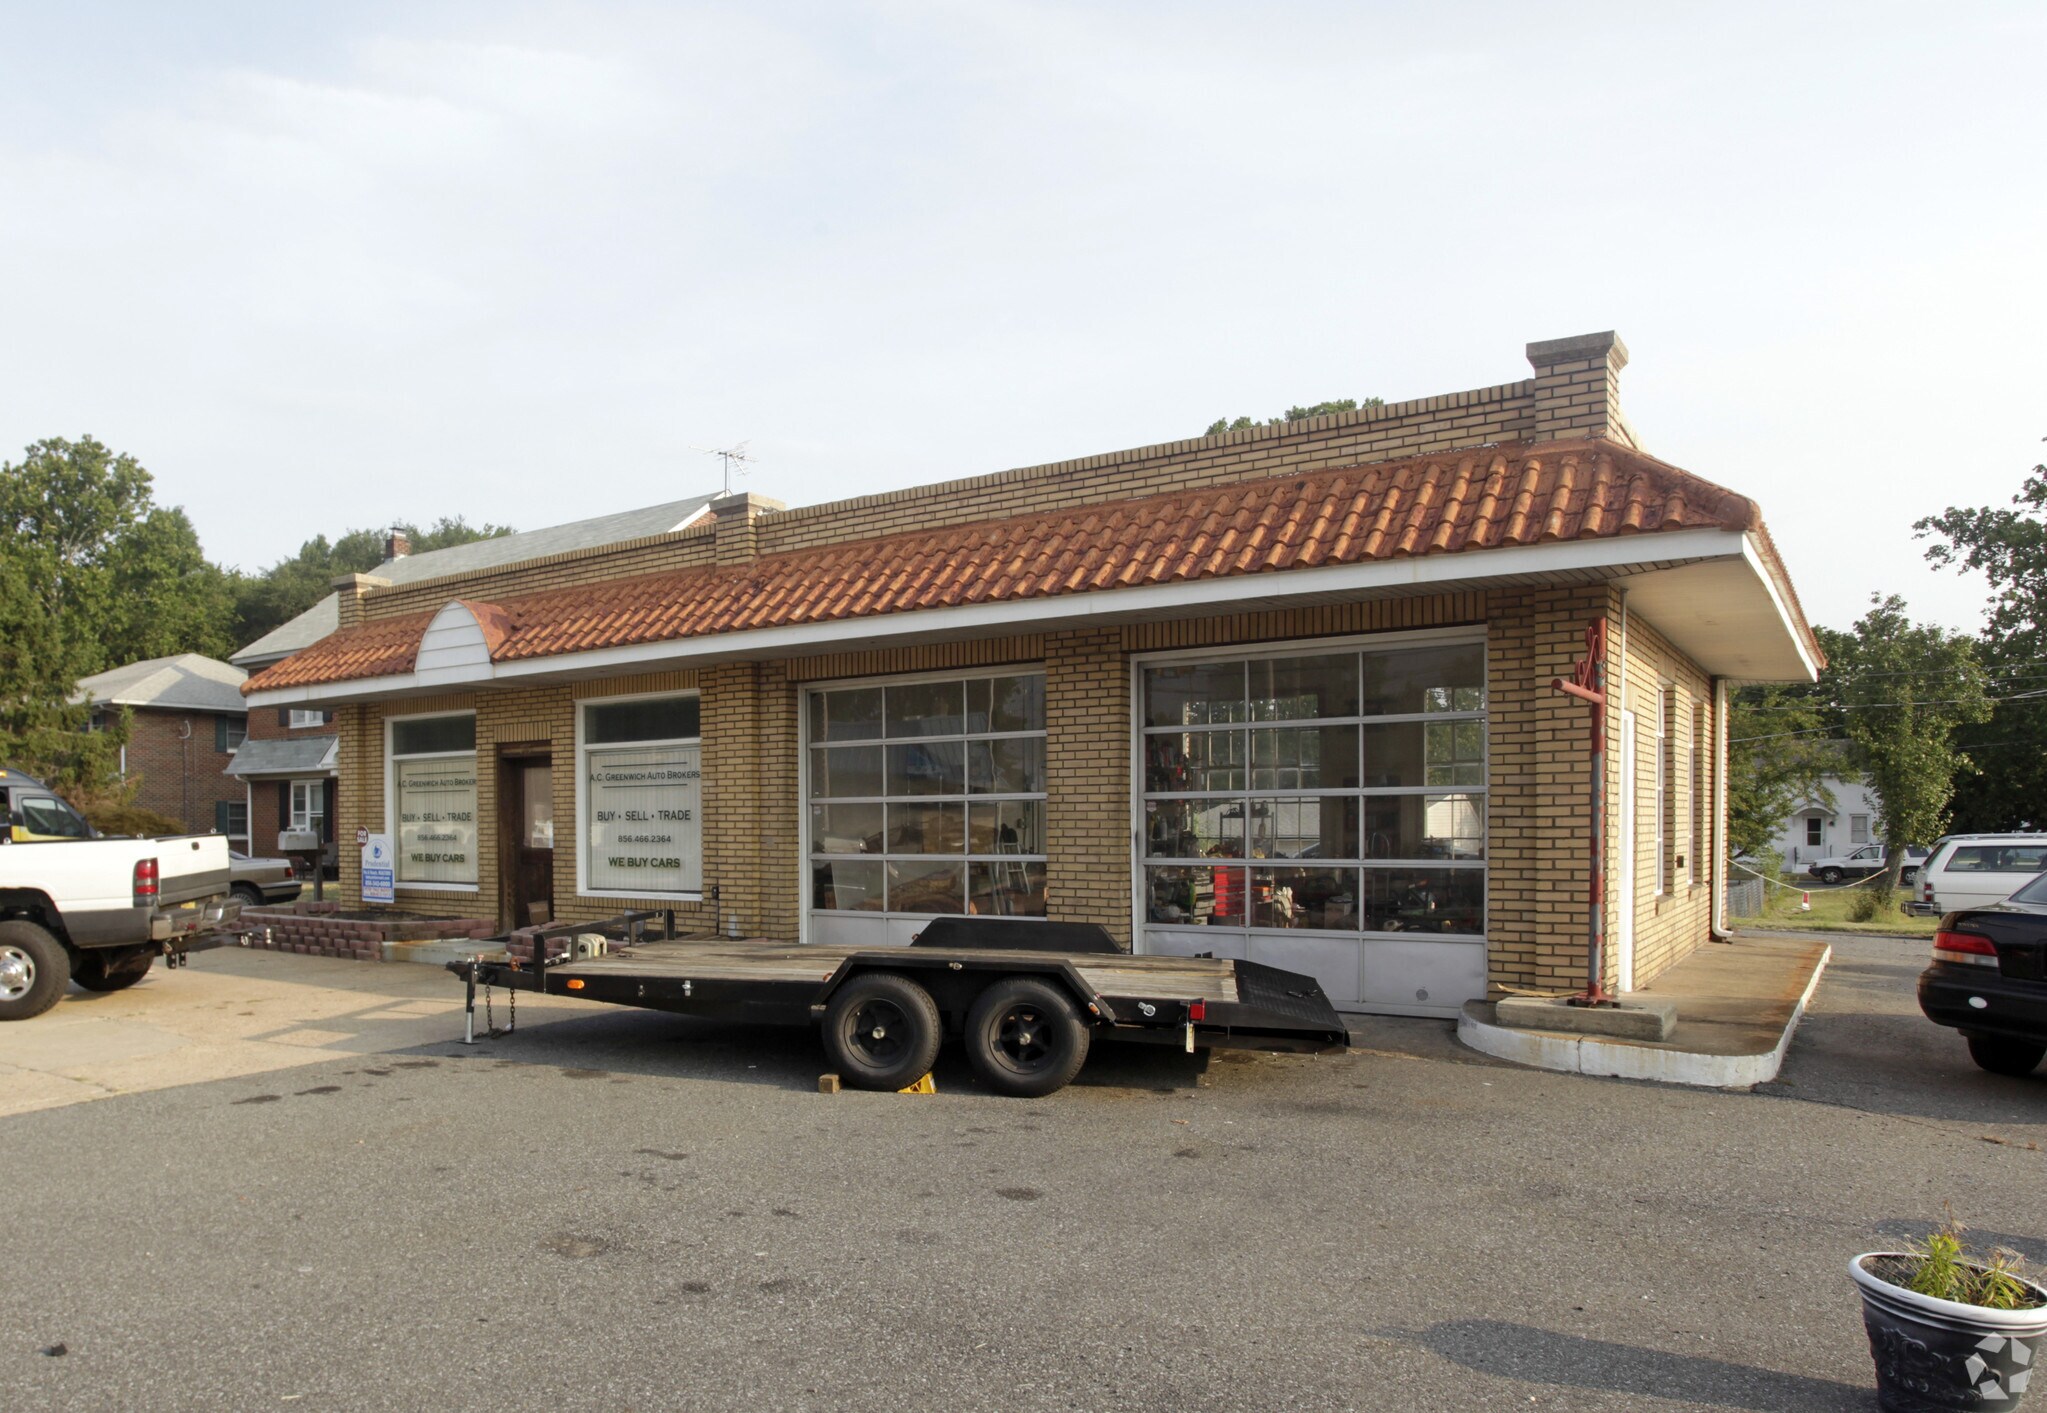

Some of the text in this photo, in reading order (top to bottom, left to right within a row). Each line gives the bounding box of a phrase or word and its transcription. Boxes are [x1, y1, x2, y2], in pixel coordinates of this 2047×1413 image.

[605, 772, 646, 782] GREENWICH
[647, 771, 666, 780] AUTO
[667, 770, 701, 780] BROKERS
[408, 779, 439, 788] GREENWICH
[439, 778, 454, 786] AUTO
[454, 777, 477, 786] BROKER
[402, 811, 471, 822] BUY SELL TRADE
[597, 810, 691, 821] BUY SELL TRADE
[617, 835, 672, 843] 856.466.2364
[410, 853, 465, 863] WE BUY CARS
[608, 857, 681, 868] WE BUY CARS
